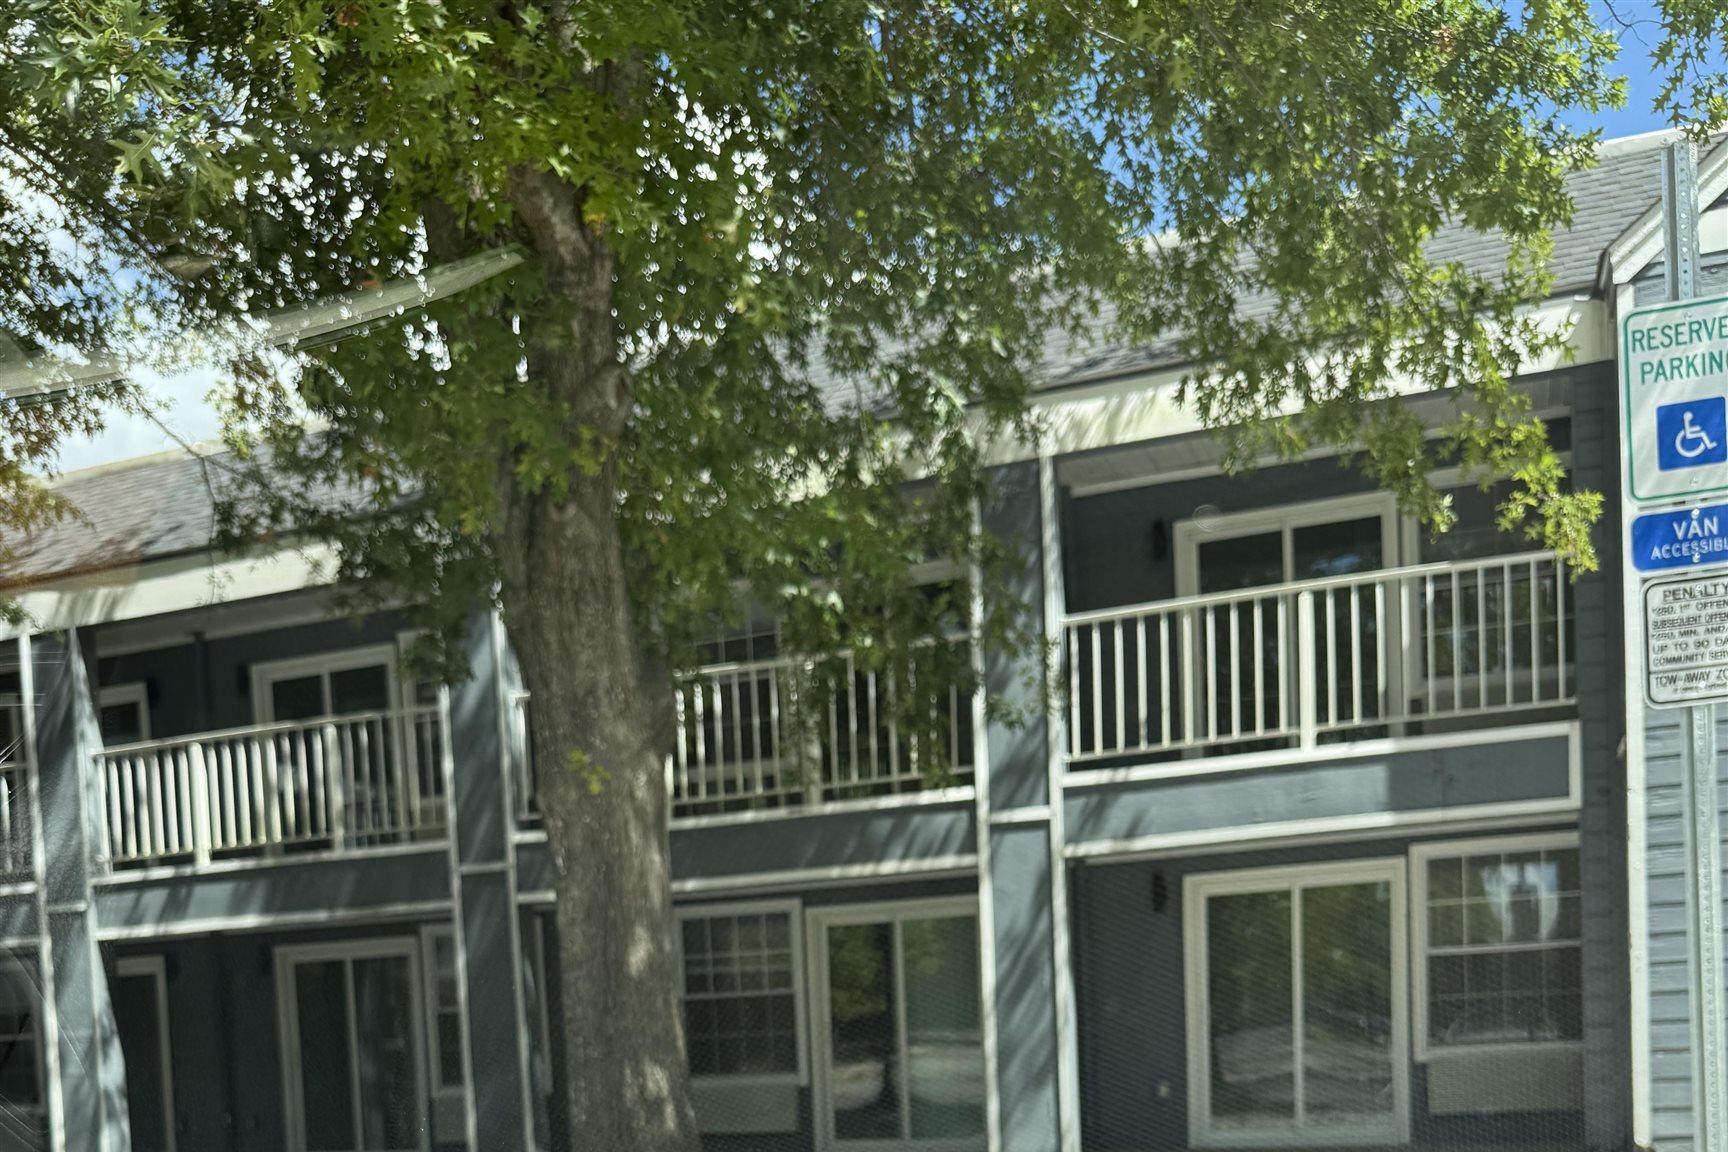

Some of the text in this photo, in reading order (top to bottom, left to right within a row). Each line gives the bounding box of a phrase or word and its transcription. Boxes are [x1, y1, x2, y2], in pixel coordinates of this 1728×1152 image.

[1641, 350, 1728, 385] PARKIN
[1672, 515, 1719, 540] VAN
[1674, 640, 1688, 652] TO
[1653, 651, 1705, 667] COMMUNITY
